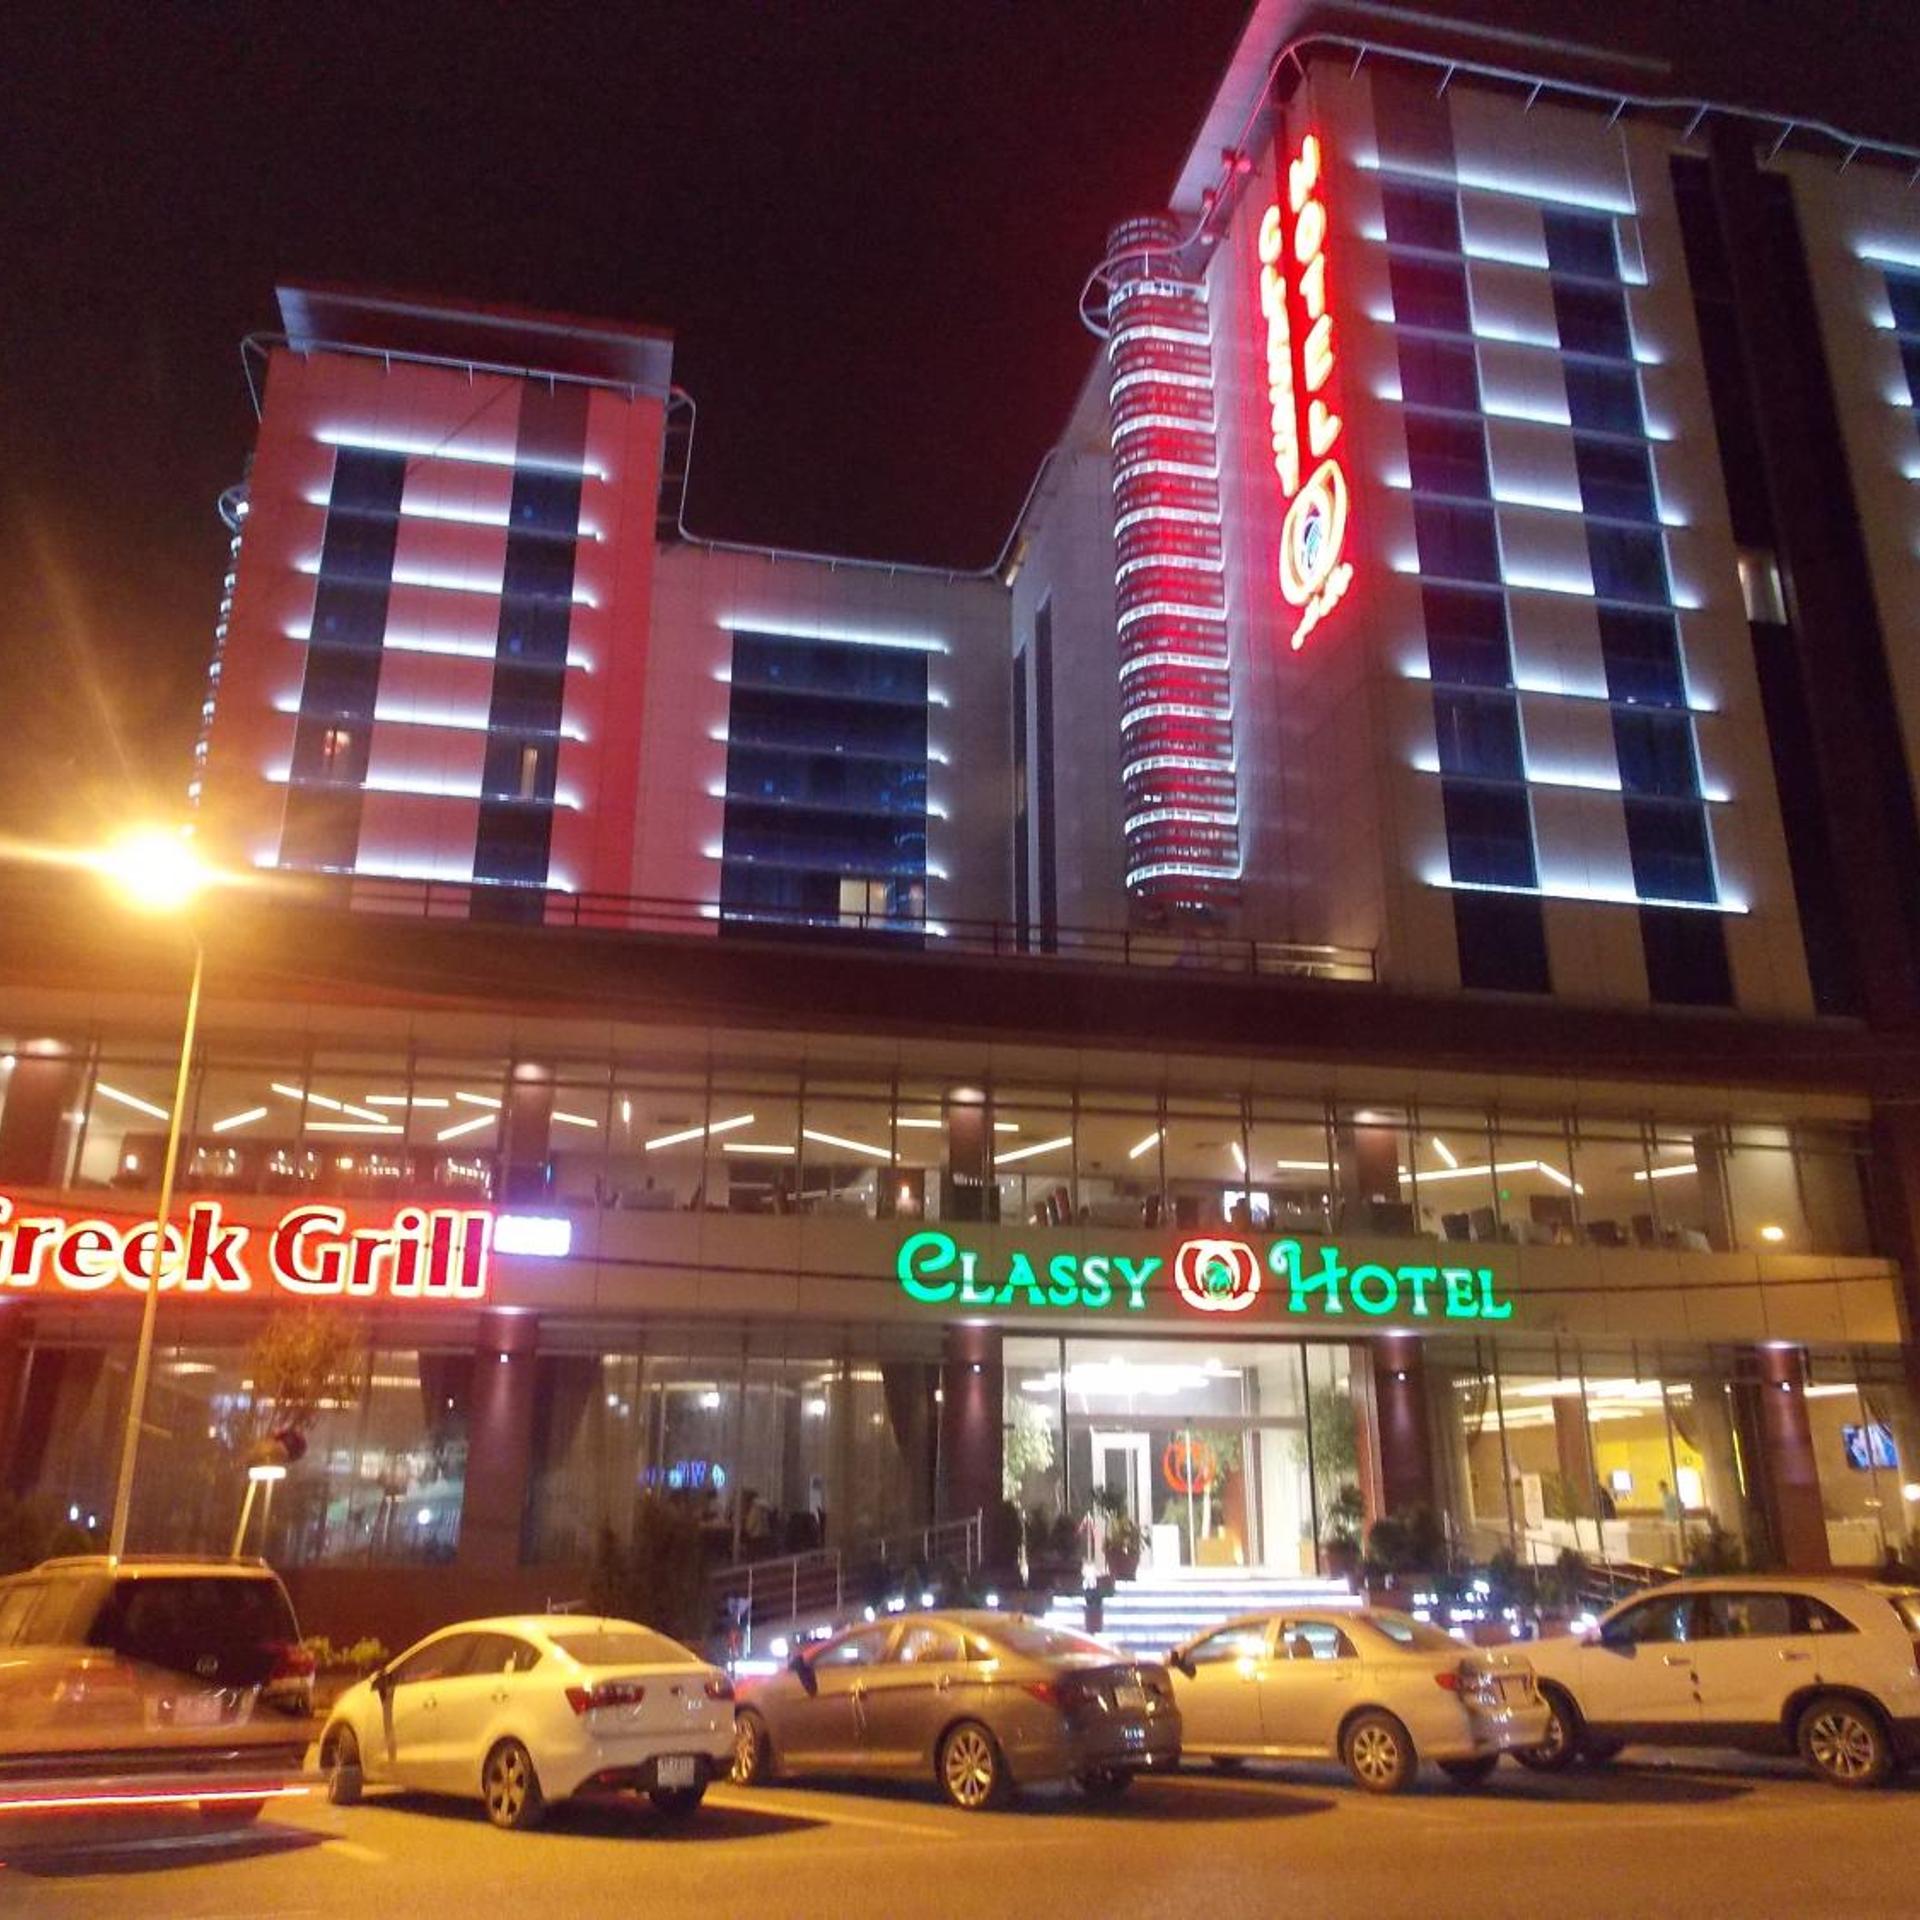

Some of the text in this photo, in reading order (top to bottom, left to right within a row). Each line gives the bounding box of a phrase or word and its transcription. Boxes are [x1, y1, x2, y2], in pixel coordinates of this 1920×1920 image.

[0, 1196, 493, 1297] reek Grill
[898, 1232, 1512, 1319] CLASSY HOTEL
